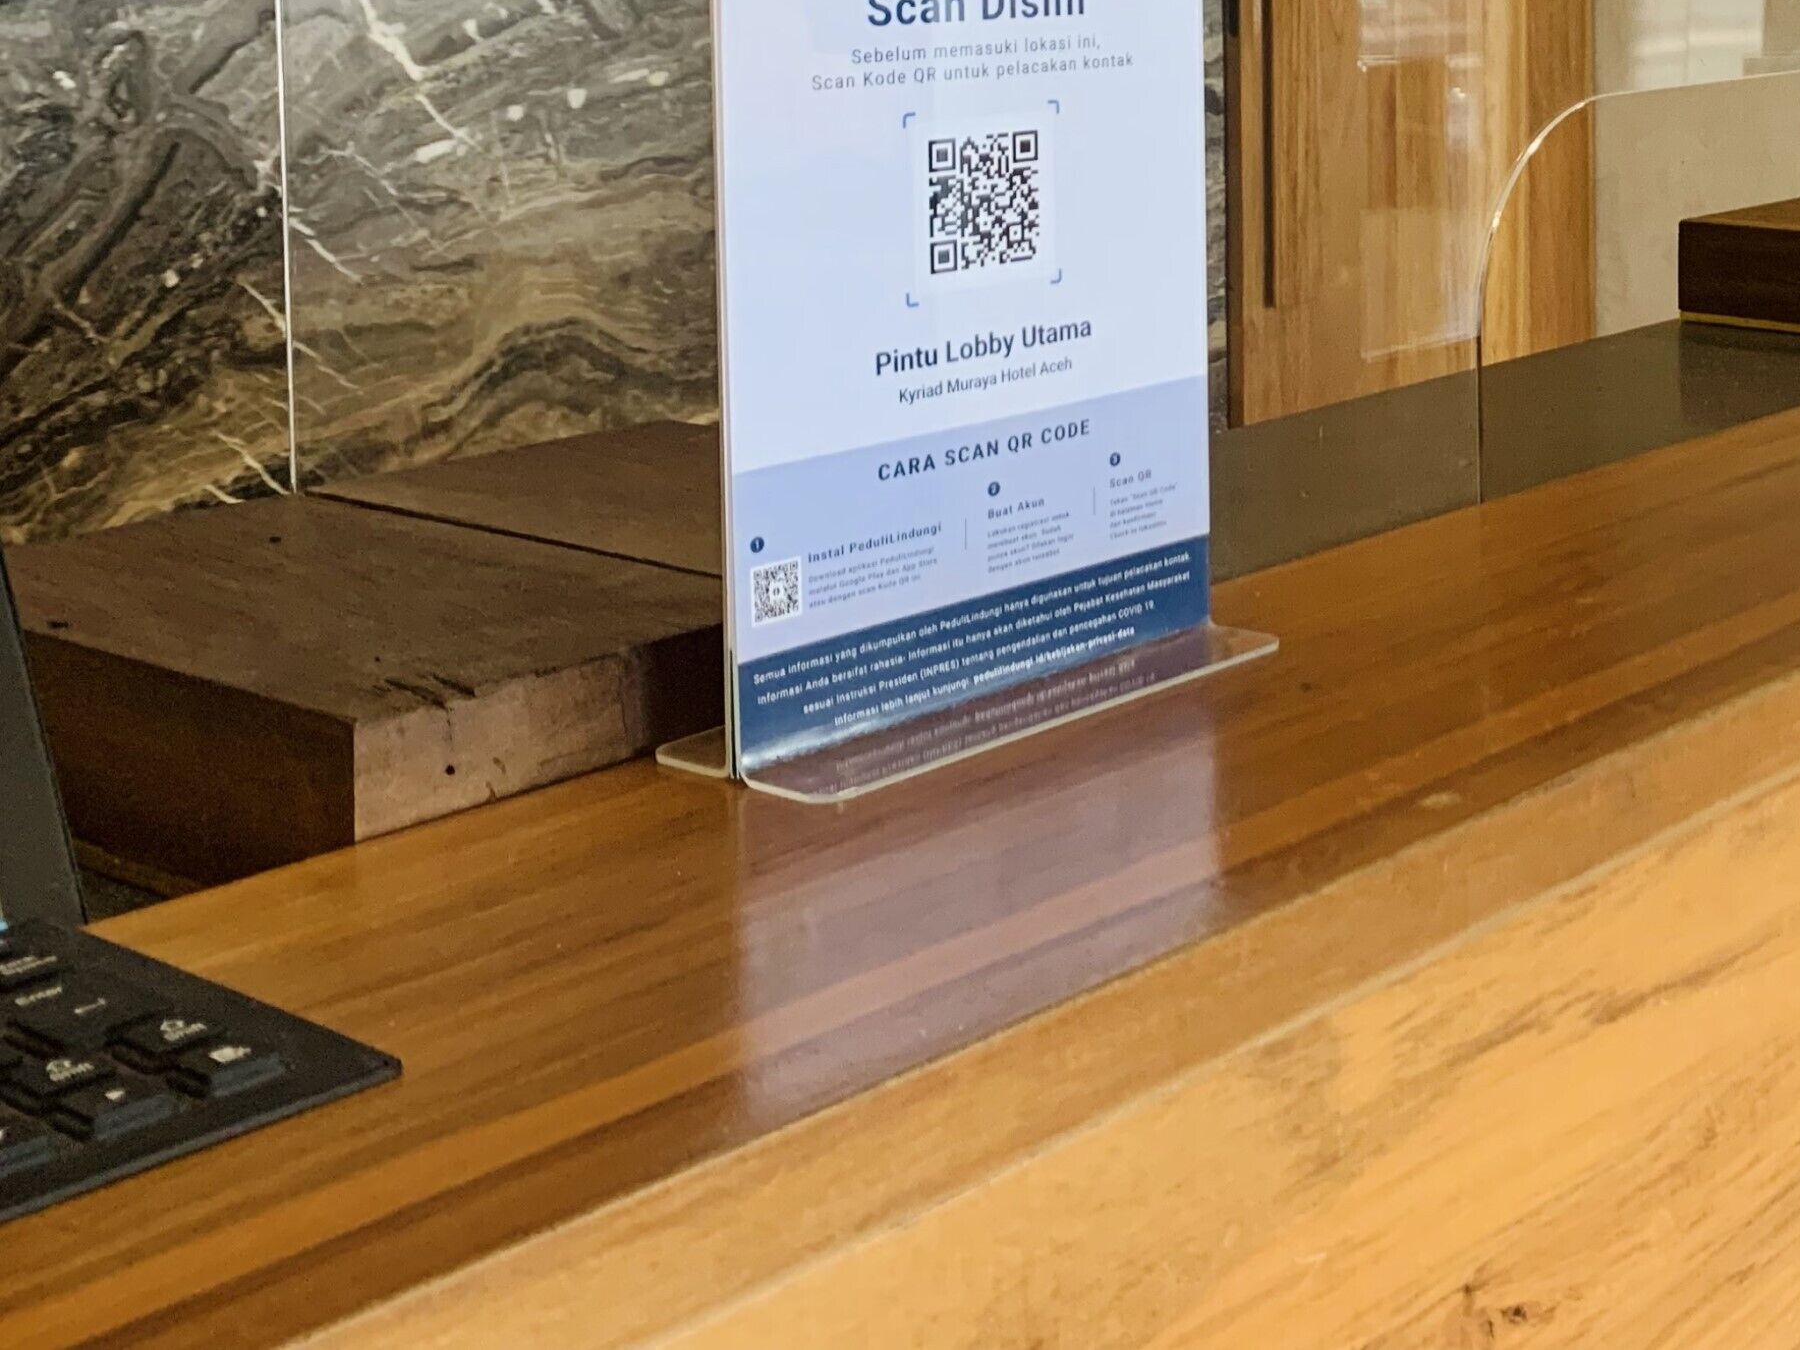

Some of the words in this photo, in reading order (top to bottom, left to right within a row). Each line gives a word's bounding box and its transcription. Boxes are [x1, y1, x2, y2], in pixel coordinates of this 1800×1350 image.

[811, 74, 856, 91] Scan
[863, 68, 907, 87] Kode
[913, 66, 937, 84] QR
[944, 59, 990, 81] untuk
[996, 58, 1077, 85] pelacakan
[1082, 52, 1134, 71] kontak
[851, 47, 927, 65] Sebelum
[933, 39, 1018, 60] memasuki
[1024, 35, 1072, 52] lokasi
[1077, 33, 1101, 50] ini,
[875, 347, 938, 376] Pintu
[945, 331, 1015, 363] Lobby
[1022, 319, 1092, 348] Utama
[899, 380, 943, 405] Kyriad
[947, 372, 998, 394] Muraya
[1001, 362, 1037, 383] Hotel
[1039, 356, 1073, 376] Aceh
[878, 453, 937, 481] CARA
[944, 439, 1000, 466] SCAN
[1007, 432, 1033, 453] QR
[1040, 418, 1091, 446] CODE
[1109, 475, 1134, 489] Scan
[987, 505, 1013, 520] Buat
[1017, 498, 1045, 512] Akun
[808, 544, 845, 564] Instal
[849, 521, 942, 554] PeduliLindungi
[753, 667, 786, 685] Semua
[834, 646, 858, 664] yang
[859, 630, 917, 655] dikumpulkan
[918, 624, 938, 638] oleh
[940, 606, 1003, 632] PeduliLindungi
[1003, 597, 1030, 614] hanya
[1030, 585, 1073, 606] digunakan
[1074, 578, 1097, 593] untuk
[1098, 571, 1123, 588] tujuan
[1124, 560, 1163, 581] pelacakan
[805, 676, 830, 692] Anda
[831, 664, 868, 683] bersifat
[951, 637, 964, 649] itu
[965, 629, 992, 647] hanya
[993, 622, 1014, 637] akan
[1015, 610, 1053, 630] diketahui
[1053, 606, 1072, 619] oleh
[1073, 594, 1104, 614] Pejabat
[1104, 583, 1146, 604] Kesehatan
[1147, 570, 1191, 591] Masyarakat
[803, 698, 834, 715] sesuai
[878, 671, 919, 692] Presiden
[920, 662, 960, 682] (INPRES)
[961, 649, 995, 667] tentang
[996, 630, 1051, 657] pengendalian
[1052, 627, 1068, 640] dan
[1069, 610, 1117, 635] pencegahan
[1117, 602, 1143, 620] COVID
[880, 697, 903, 713] lebih
[904, 689, 931, 706] lanjut
